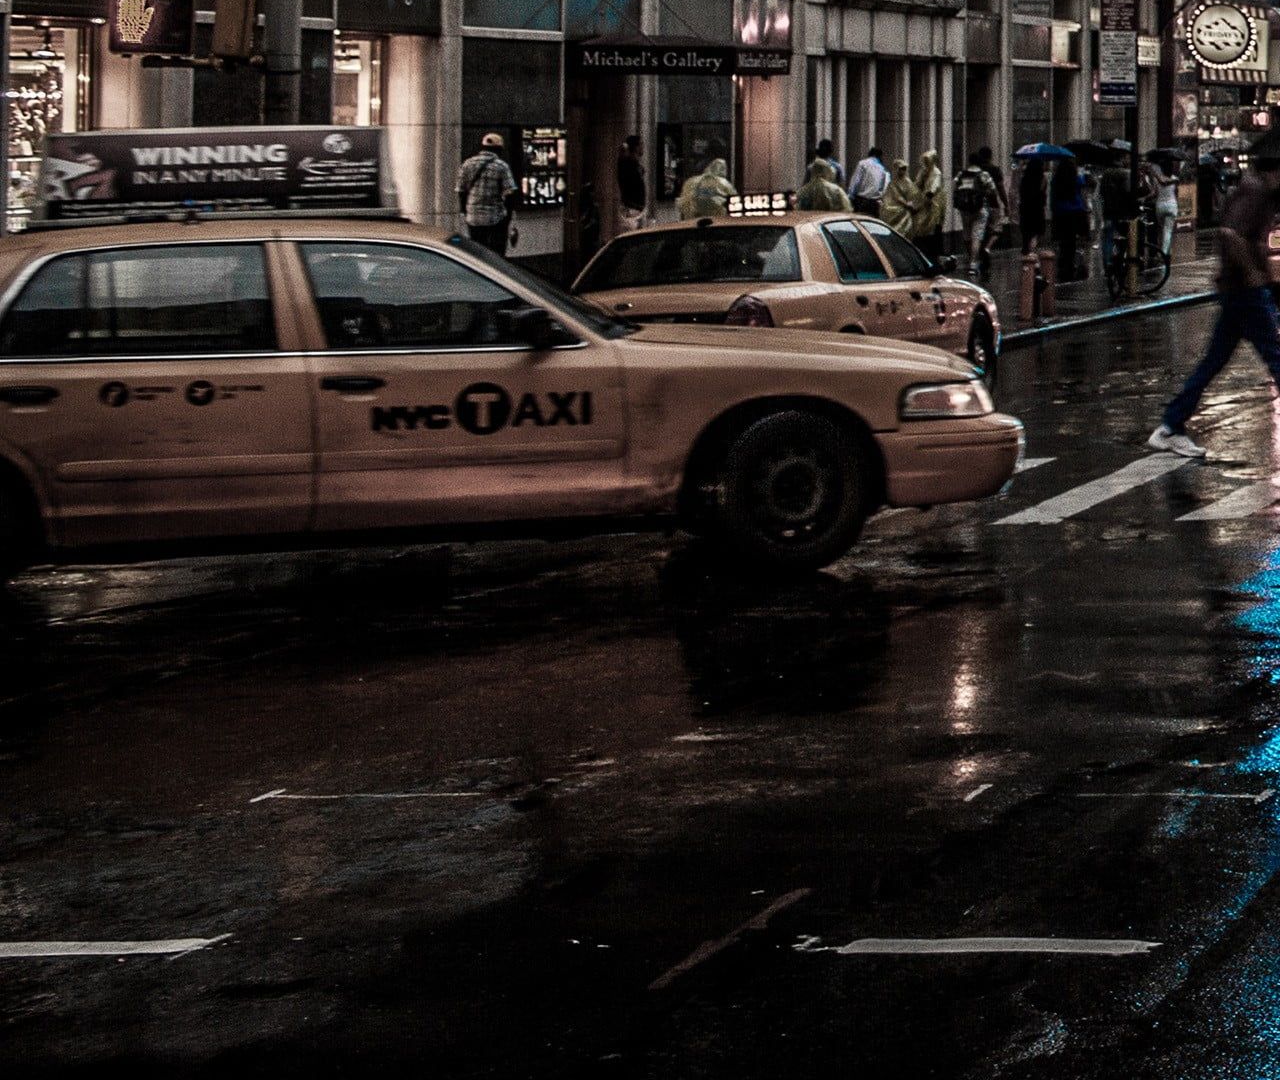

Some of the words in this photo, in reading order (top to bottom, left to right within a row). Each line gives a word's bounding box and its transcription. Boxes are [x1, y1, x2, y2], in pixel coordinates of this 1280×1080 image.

[582, 50, 660, 69] Michael's
[662, 52, 723, 72] Gallery
[131, 143, 290, 167] WINNING
[372, 405, 451, 431] NYC
[460, 387, 594, 433] TAXI
